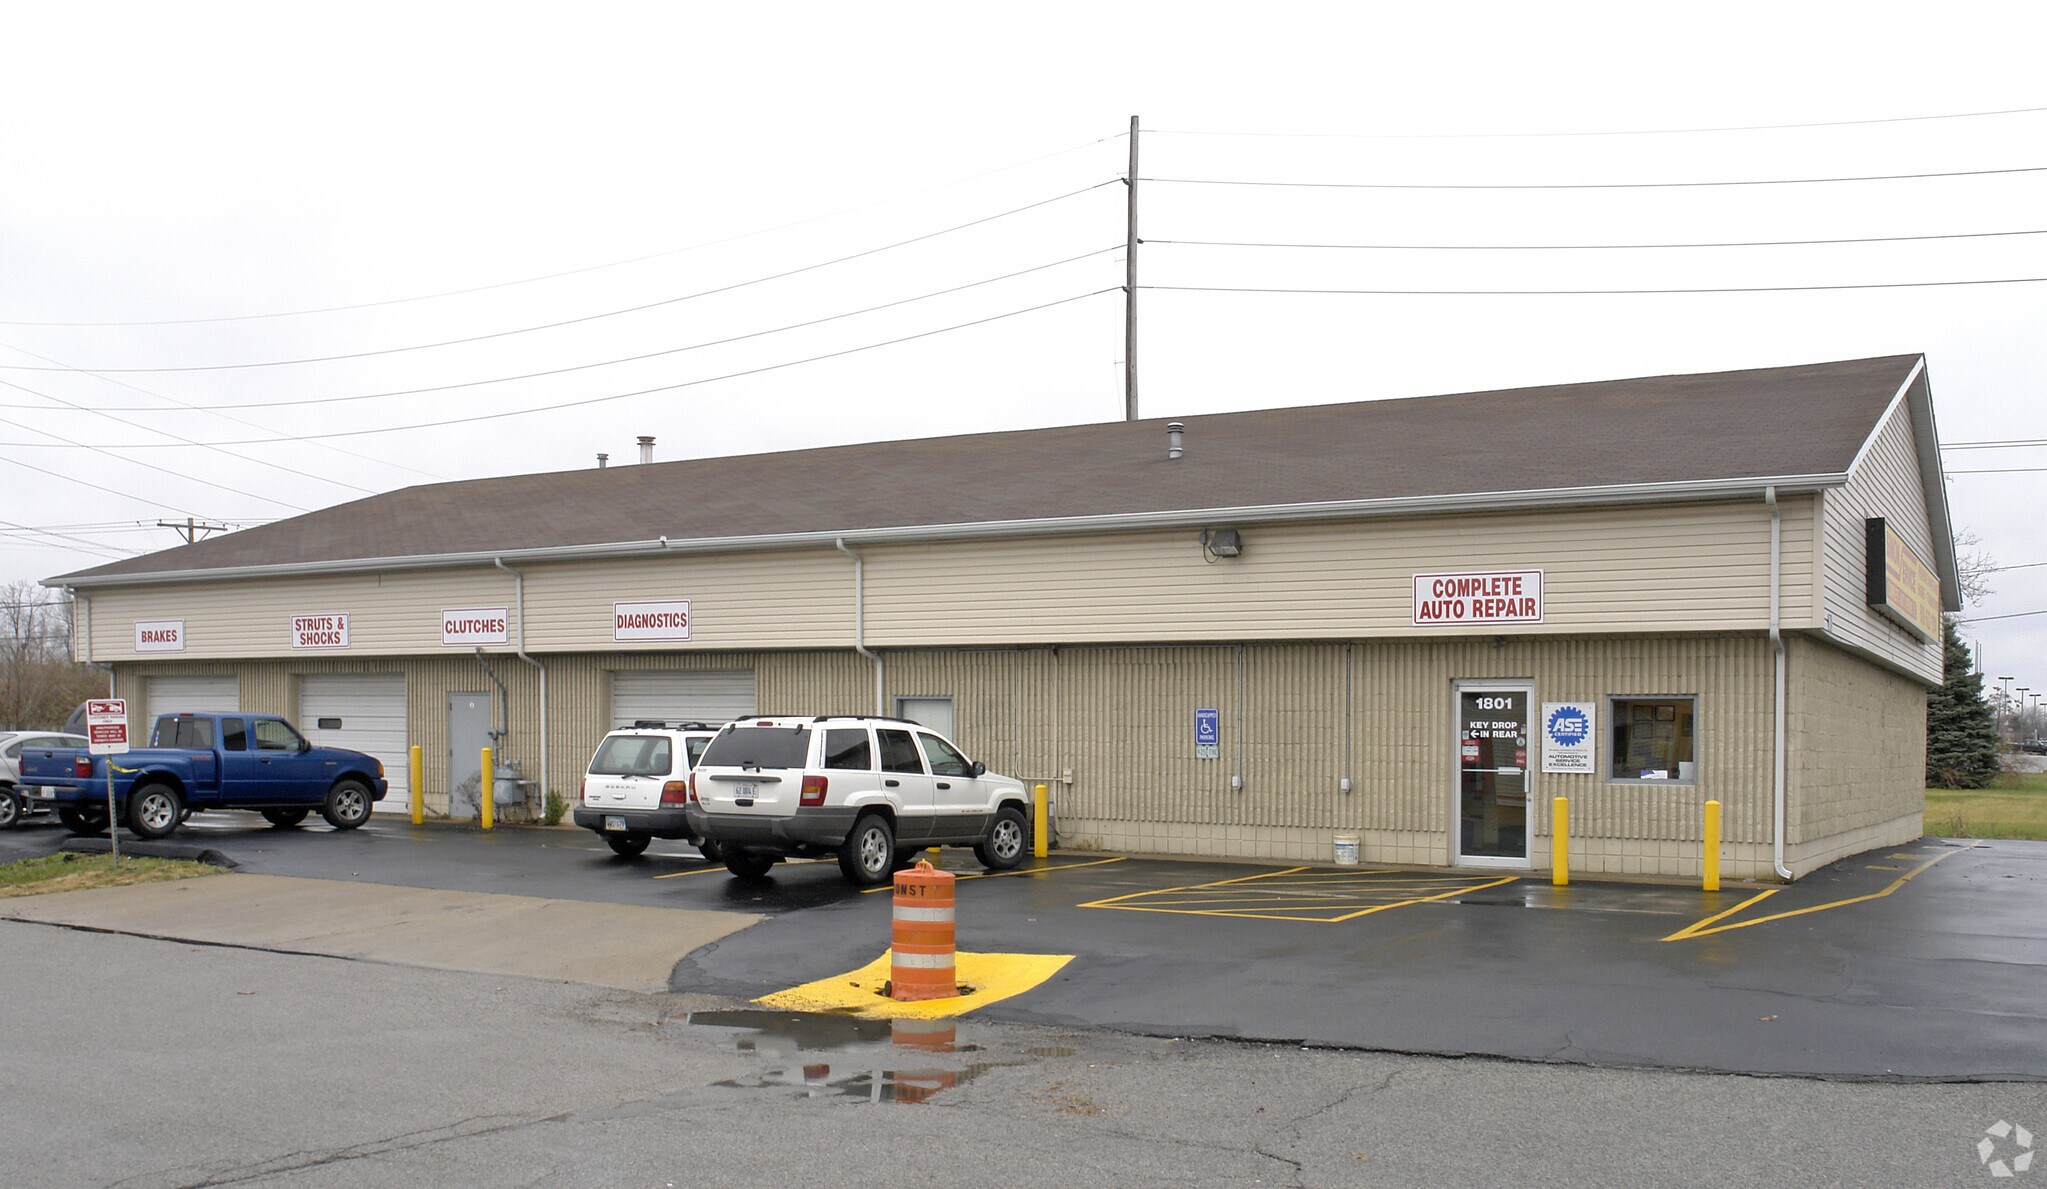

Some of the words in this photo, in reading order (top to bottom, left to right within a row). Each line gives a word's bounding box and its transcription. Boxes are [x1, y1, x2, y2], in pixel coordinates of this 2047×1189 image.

[1432, 576, 1522, 598] COMPLETE
[1419, 599, 1465, 619] AUTO
[1472, 597, 1536, 618] REPAIR
[294, 617, 333, 633] STRUTS
[336, 617, 345, 631] &
[444, 617, 505, 635] CLUTCHES
[616, 611, 688, 630] DIAGNOSTICS
[140, 629, 178, 644] BRAKES
[299, 631, 341, 646] SHOCKS
[1475, 697, 1512, 710] 1801
[1469, 721, 1489, 729] KEY
[1491, 721, 1518, 729] DROP
[1552, 717, 1583, 732] ASE
[1480, 730, 1489, 738] IN
[1492, 730, 1518, 738] REAR
